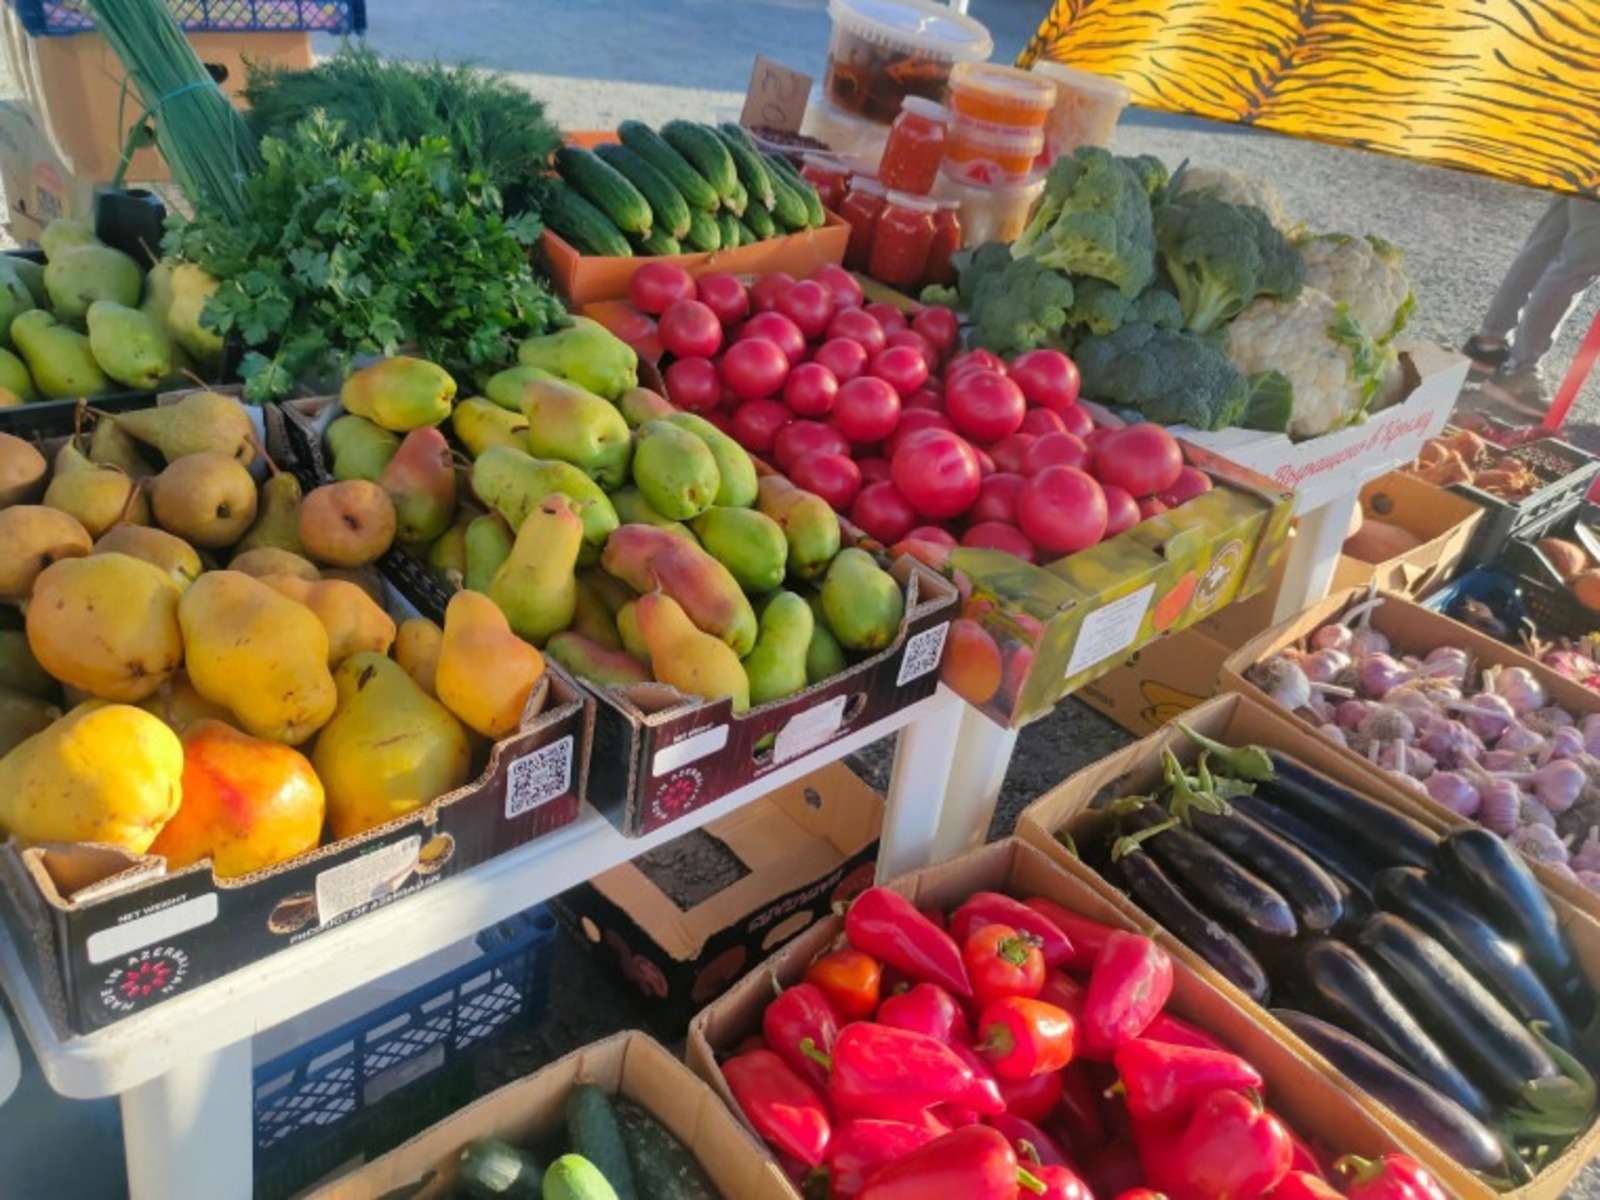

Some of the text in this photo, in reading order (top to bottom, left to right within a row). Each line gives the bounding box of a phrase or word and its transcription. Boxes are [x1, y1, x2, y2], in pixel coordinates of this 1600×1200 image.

[117, 893, 188, 923] NET WEIGHT
[100, 946, 191, 1011] MADE IN AZERBAIJAN
